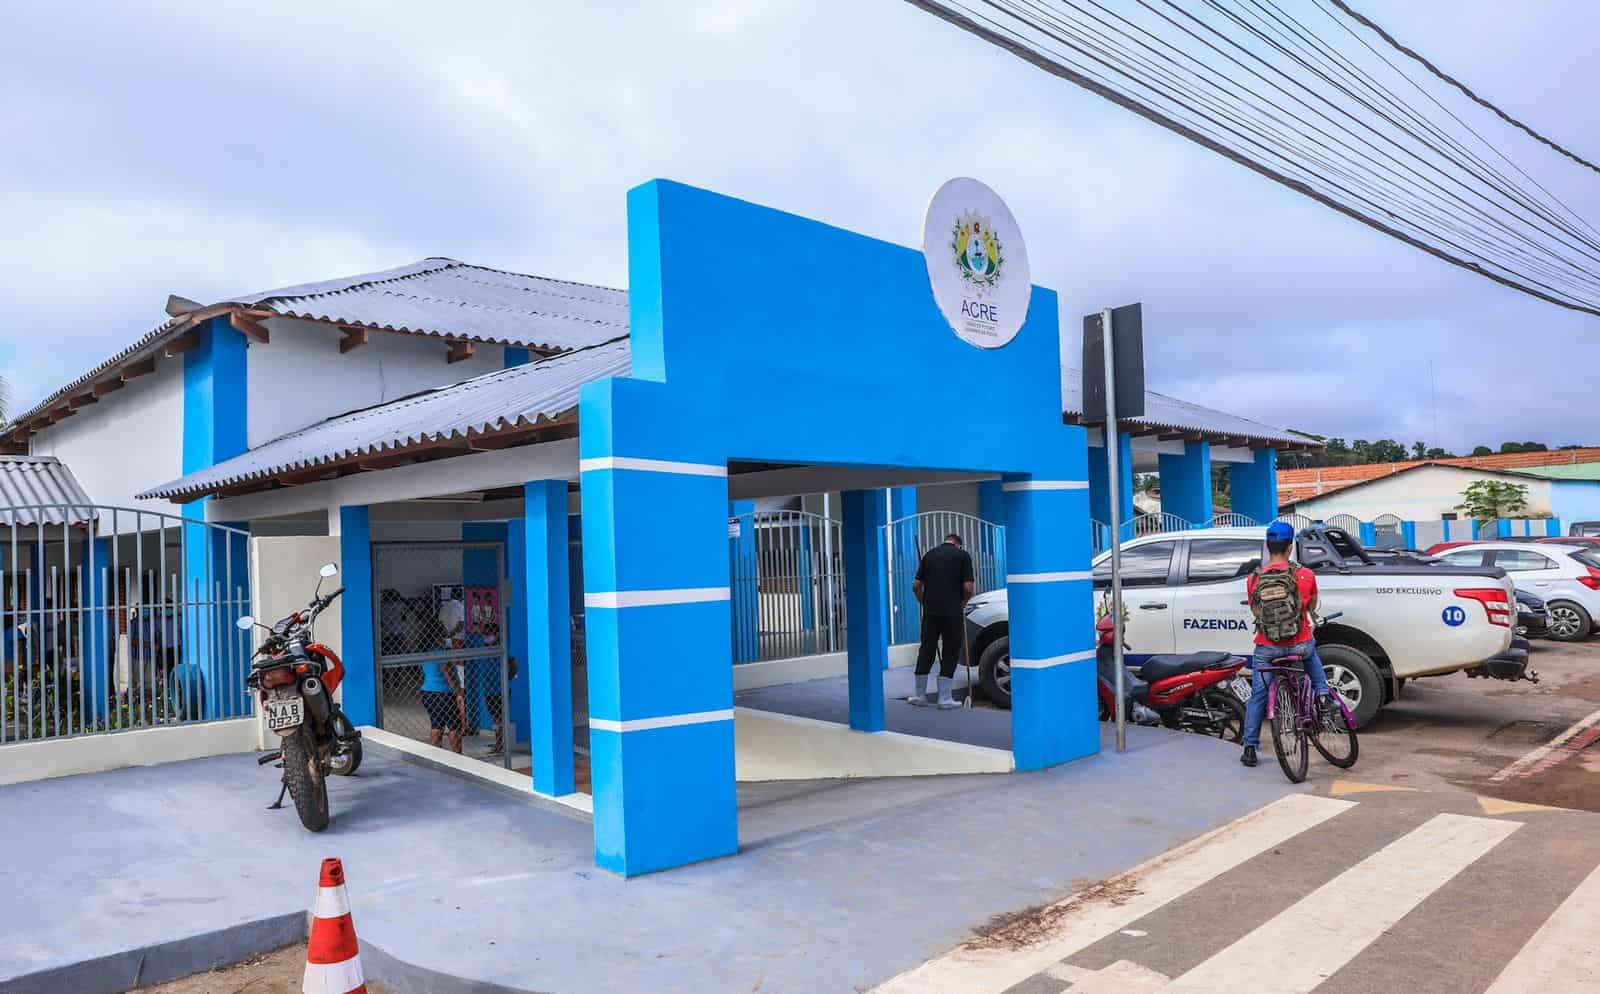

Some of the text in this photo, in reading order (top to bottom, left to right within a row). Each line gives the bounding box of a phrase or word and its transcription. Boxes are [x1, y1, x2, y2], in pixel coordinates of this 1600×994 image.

[961, 299, 998, 322] ACRE
[1396, 587, 1442, 596] EXCLUSIVO
[1446, 609, 1463, 622] 10
[1183, 618, 1248, 631] FAZENDA
[270, 704, 298, 718] NAB
[268, 714, 300, 729] 0923
